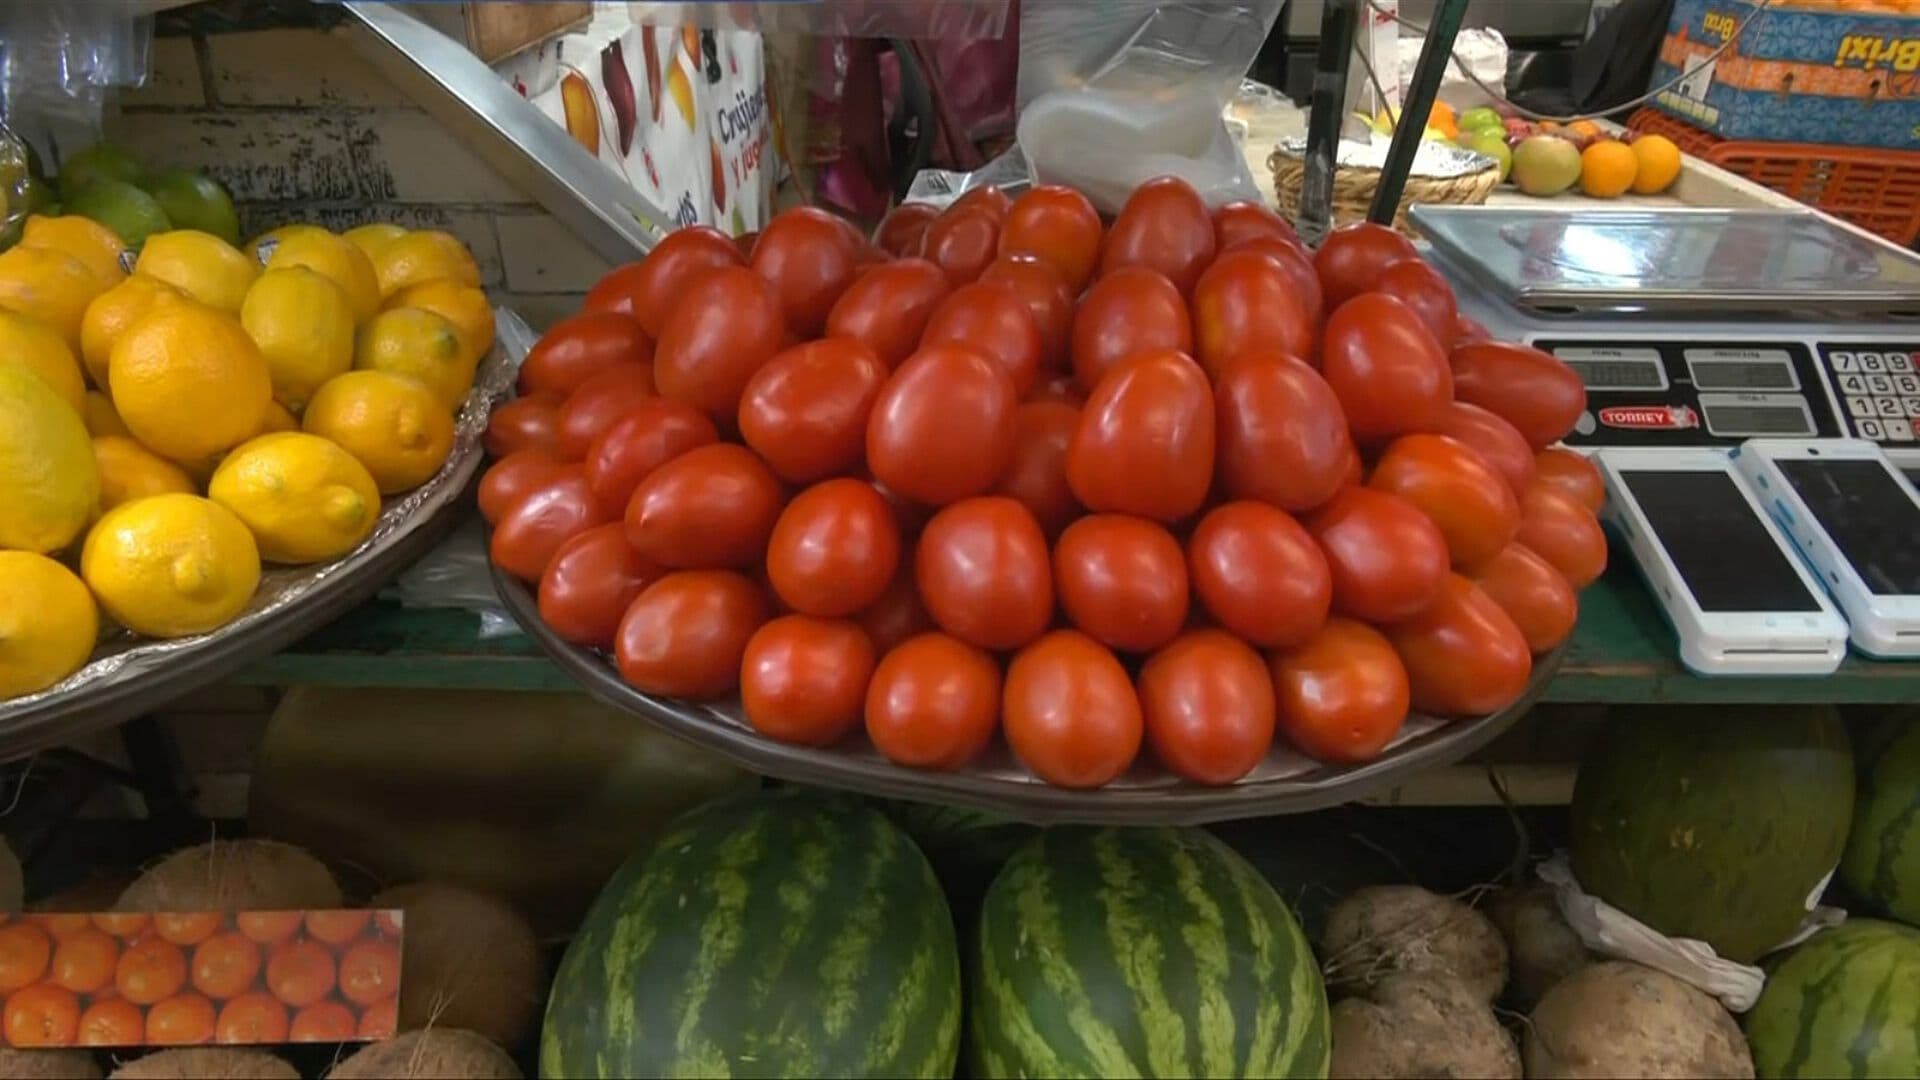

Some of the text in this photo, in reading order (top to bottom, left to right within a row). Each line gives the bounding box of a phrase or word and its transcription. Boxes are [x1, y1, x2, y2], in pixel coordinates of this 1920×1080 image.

[1833, 34, 1920, 72] Brixi
[1837, 354, 1907, 369] 7 8 9
[1847, 376, 1916, 392] 4 5 6
[1856, 398, 1868, 413] 1
[1880, 398, 1897, 413] 2
[1605, 412, 1664, 423] TORREY
[1862, 420, 1879, 436] 0
